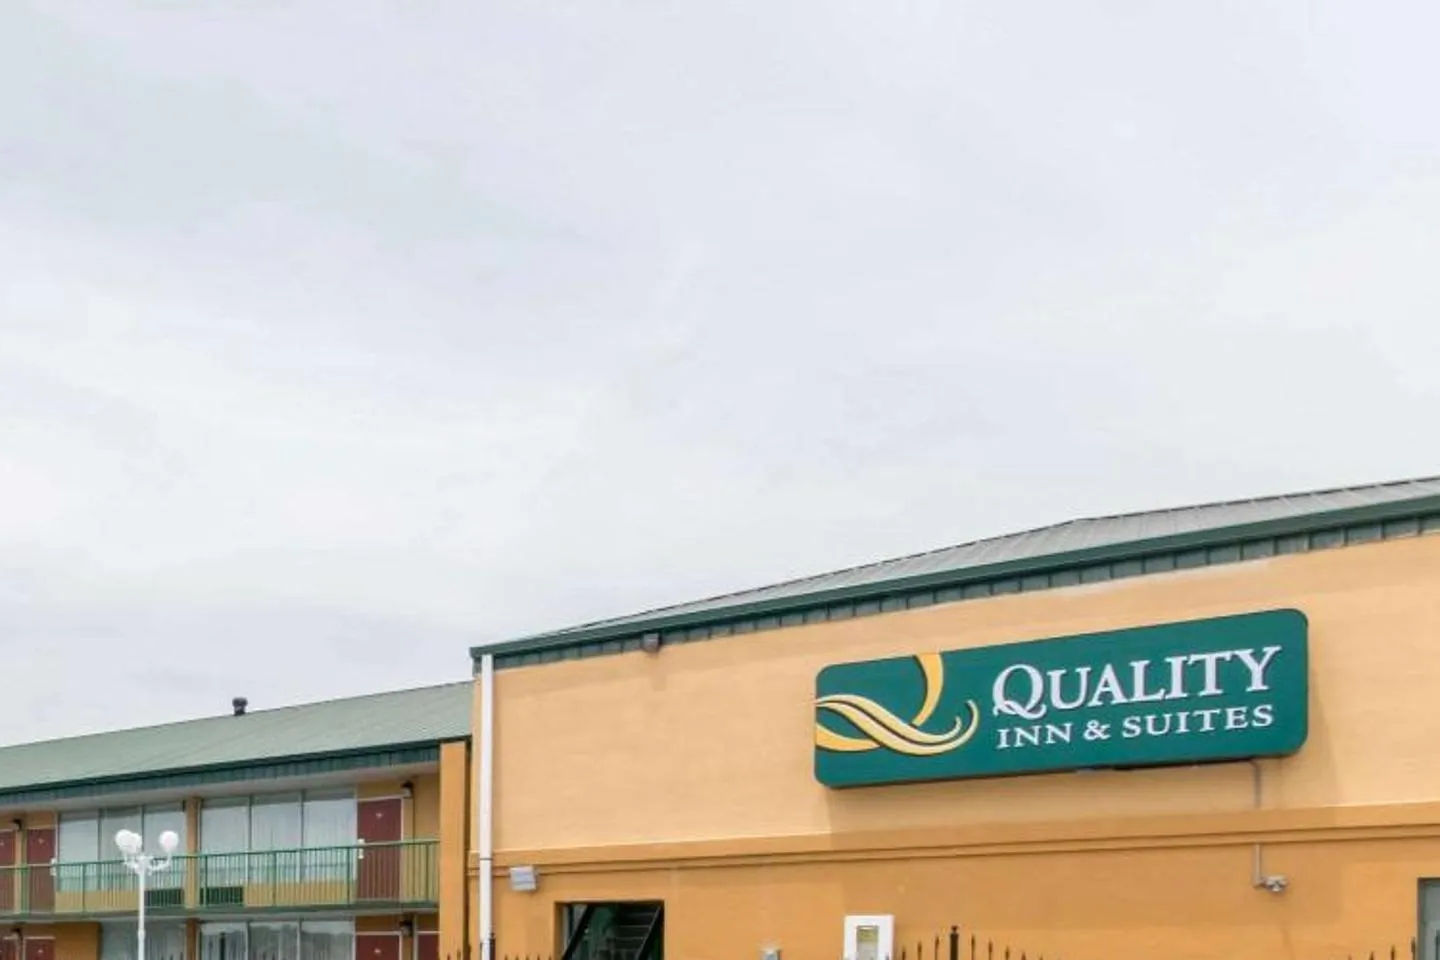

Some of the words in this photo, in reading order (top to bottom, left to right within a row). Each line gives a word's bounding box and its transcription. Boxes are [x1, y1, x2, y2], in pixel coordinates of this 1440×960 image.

[992, 645, 1282, 720] QUALITY
[995, 722, 1073, 749] INN
[1083, 719, 1111, 740] &
[1122, 704, 1274, 738] SUITES
